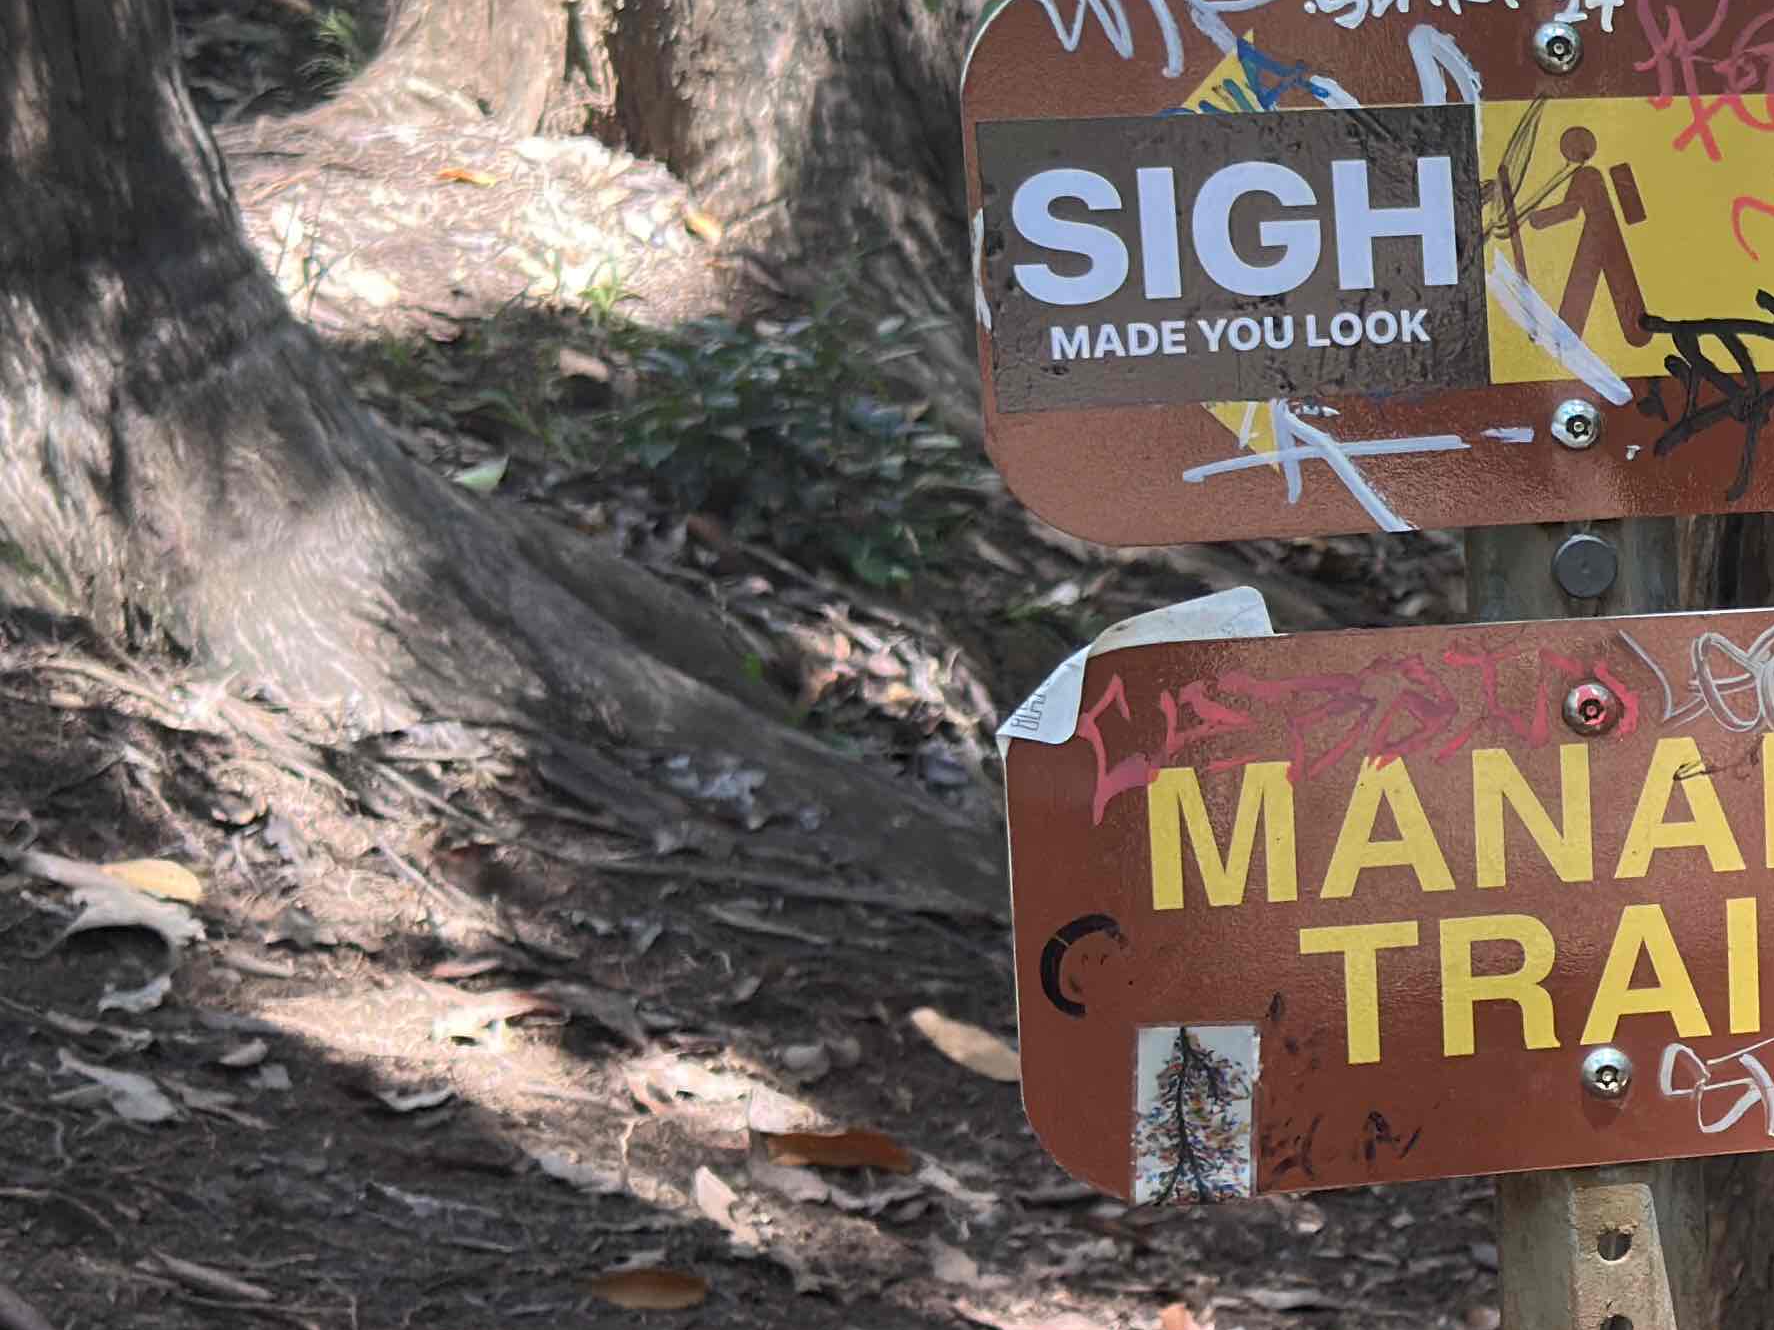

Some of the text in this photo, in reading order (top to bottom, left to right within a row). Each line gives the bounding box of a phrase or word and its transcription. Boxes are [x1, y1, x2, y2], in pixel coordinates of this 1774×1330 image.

[1012, 156, 1458, 306] SIGH
[1051, 309, 1432, 360] MADE YOU LOOK
